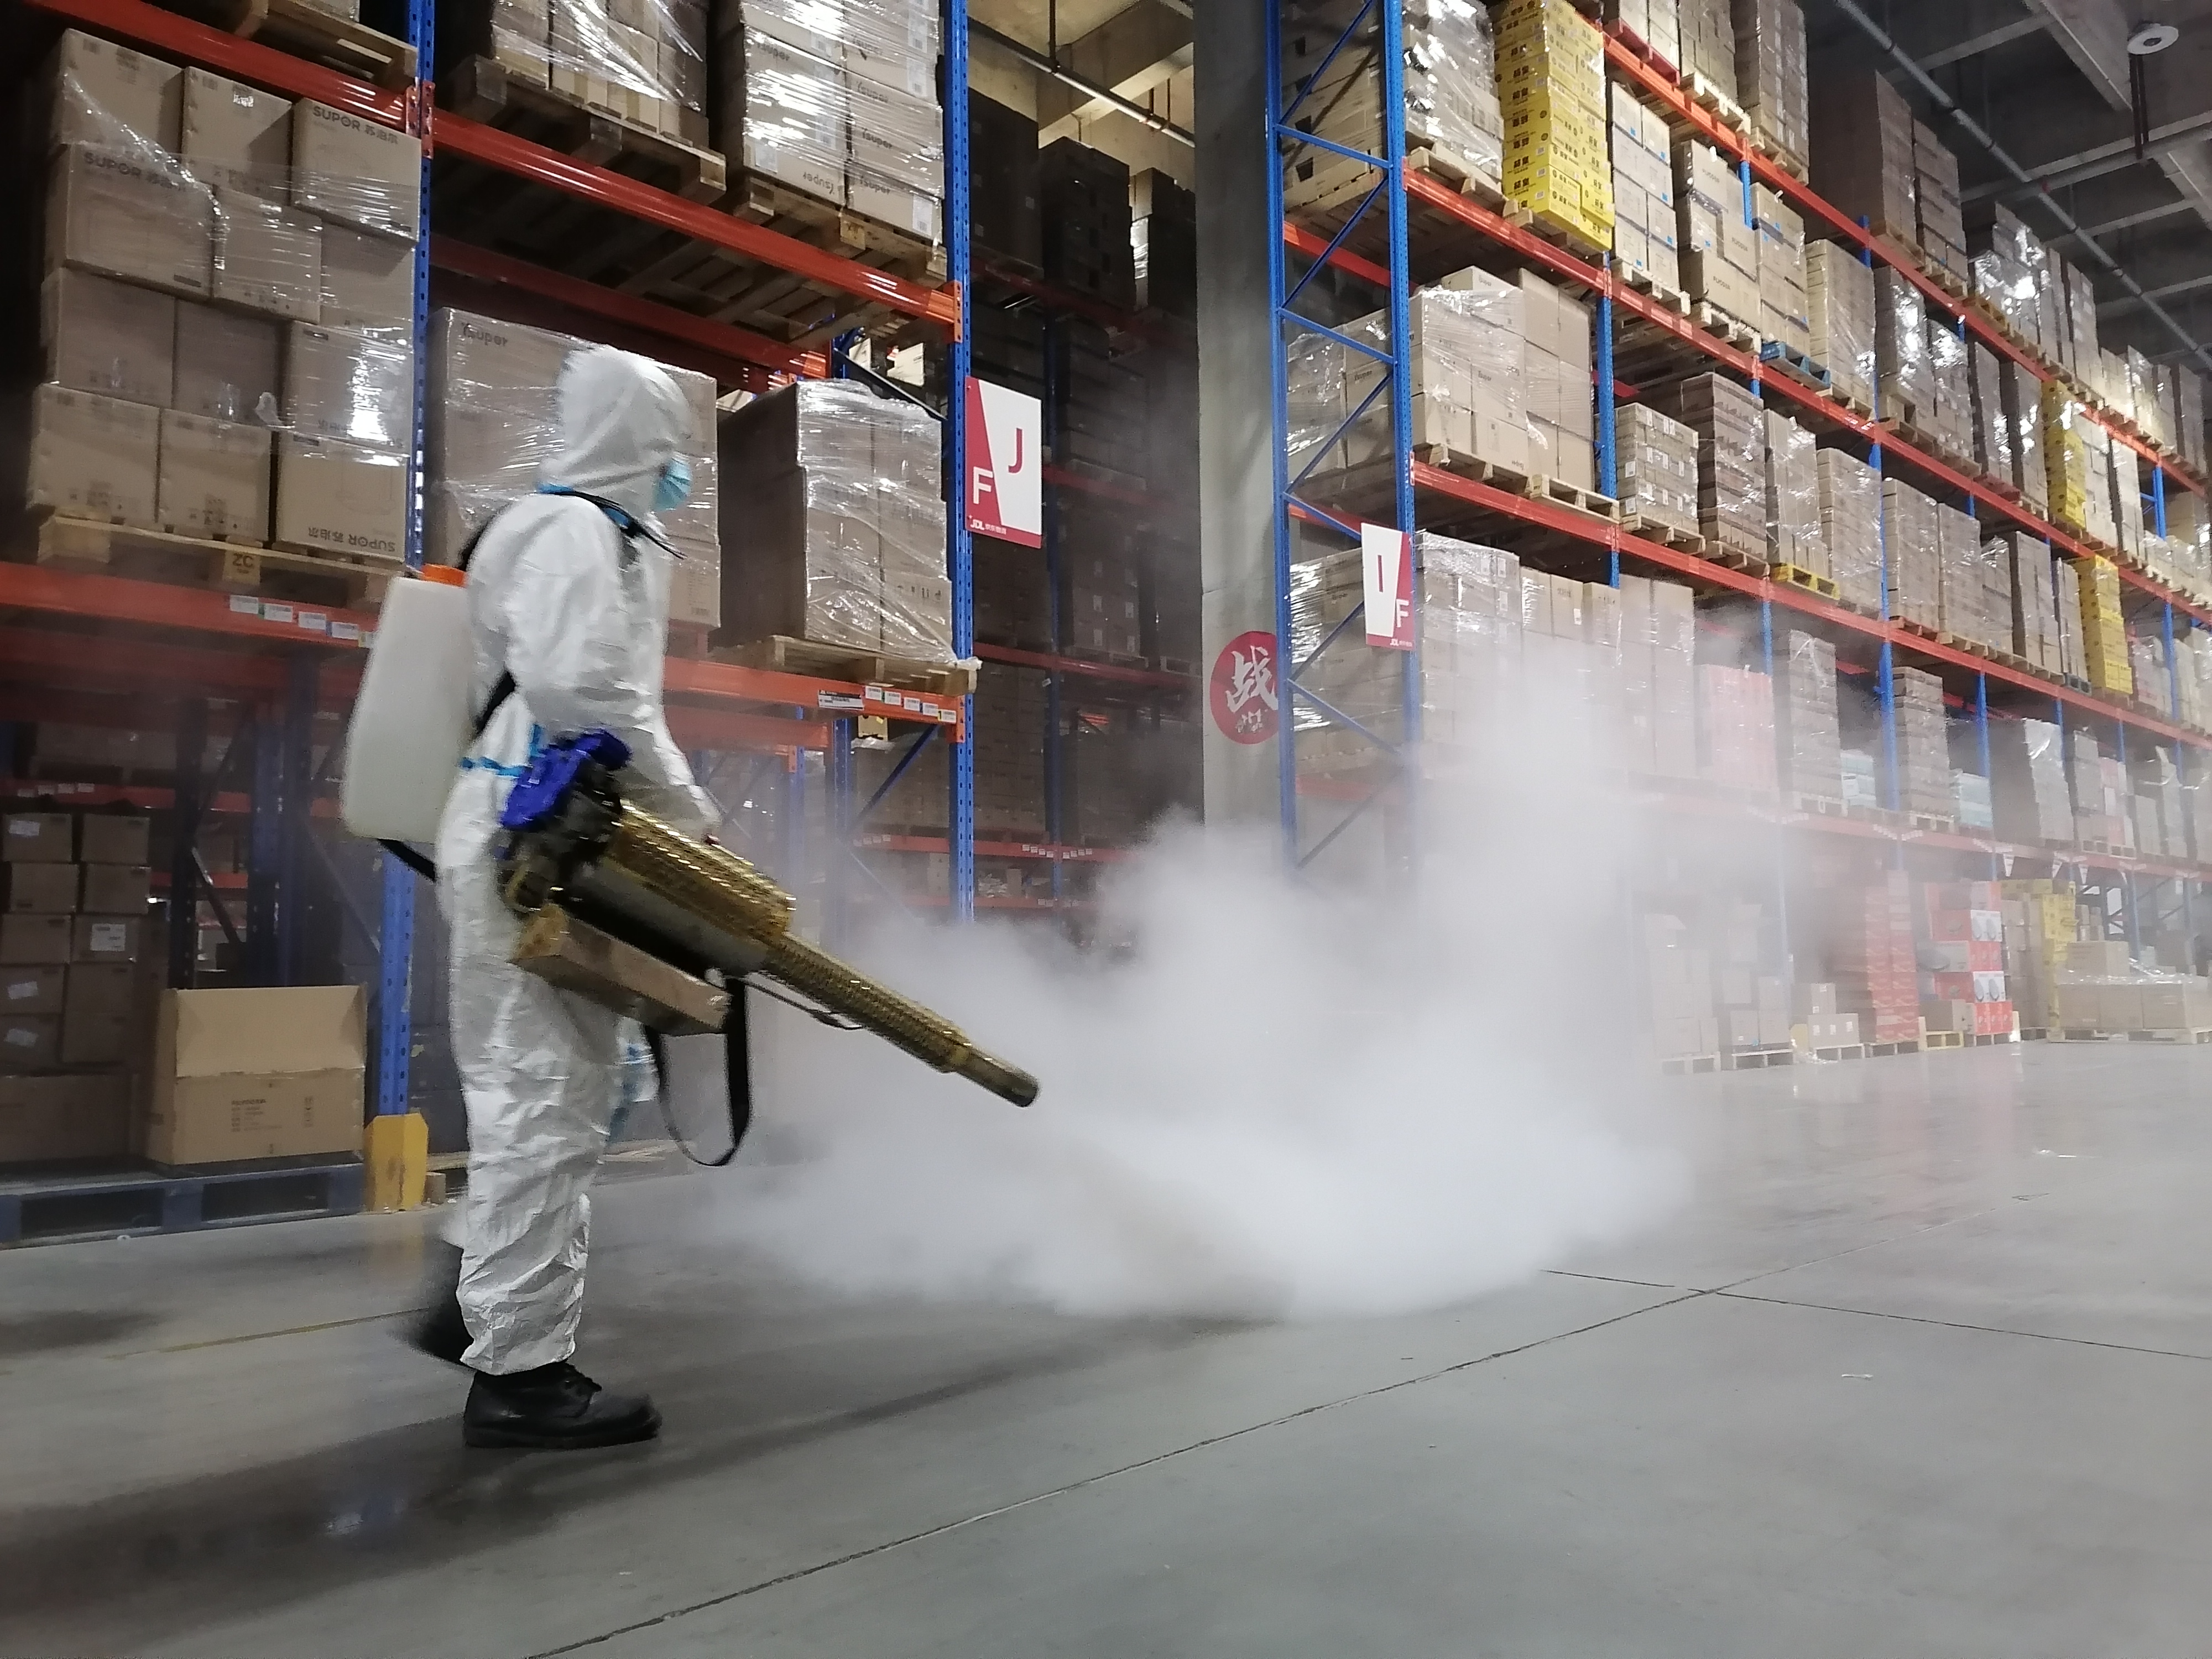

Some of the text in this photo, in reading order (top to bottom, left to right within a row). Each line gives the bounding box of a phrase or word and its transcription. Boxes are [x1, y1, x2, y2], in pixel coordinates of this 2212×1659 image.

[312, 106, 361, 132] SUPOR
[1008, 427, 1022, 473] J
[973, 466, 994, 504] F
[348, 534, 396, 552] SUPOR
[1396, 598, 1410, 628] F
[1225, 645, 1279, 713] 战
